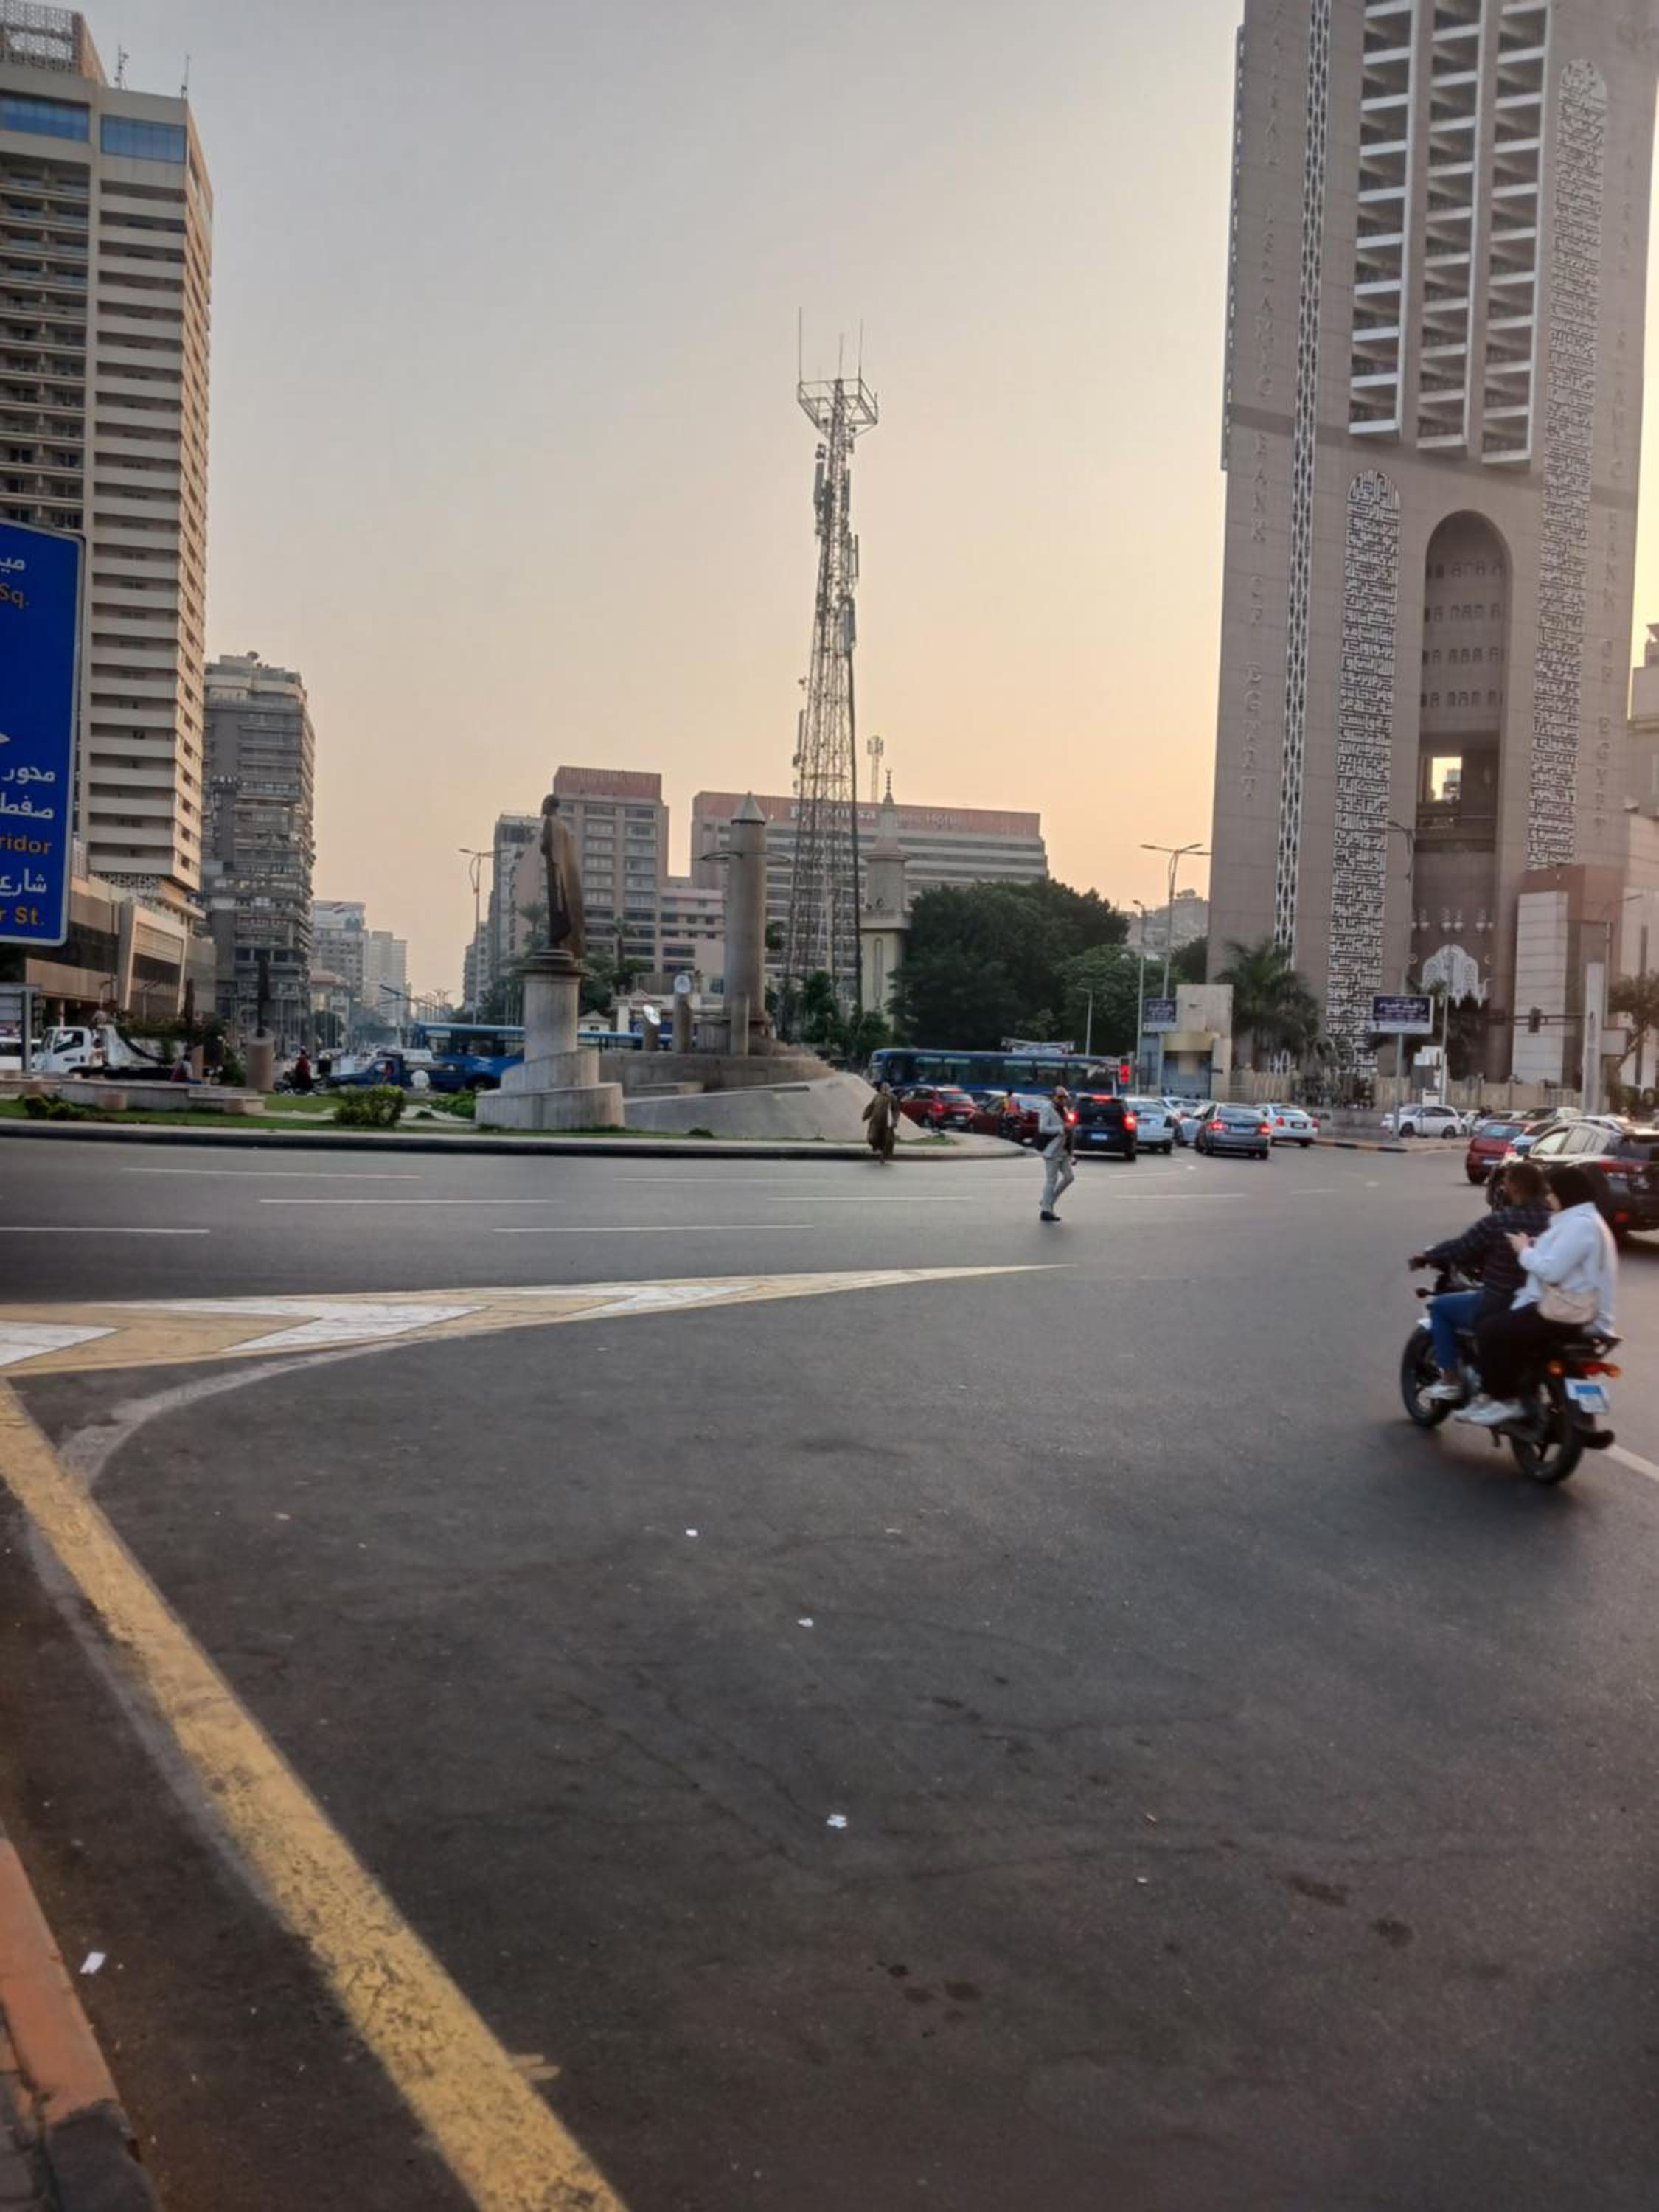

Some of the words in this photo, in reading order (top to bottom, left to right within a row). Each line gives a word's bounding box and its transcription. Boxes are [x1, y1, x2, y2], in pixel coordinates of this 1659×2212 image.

[1, 766, 56, 785] محور
[0, 867, 47, 897] شارع
[15, 906, 46, 926] St.
